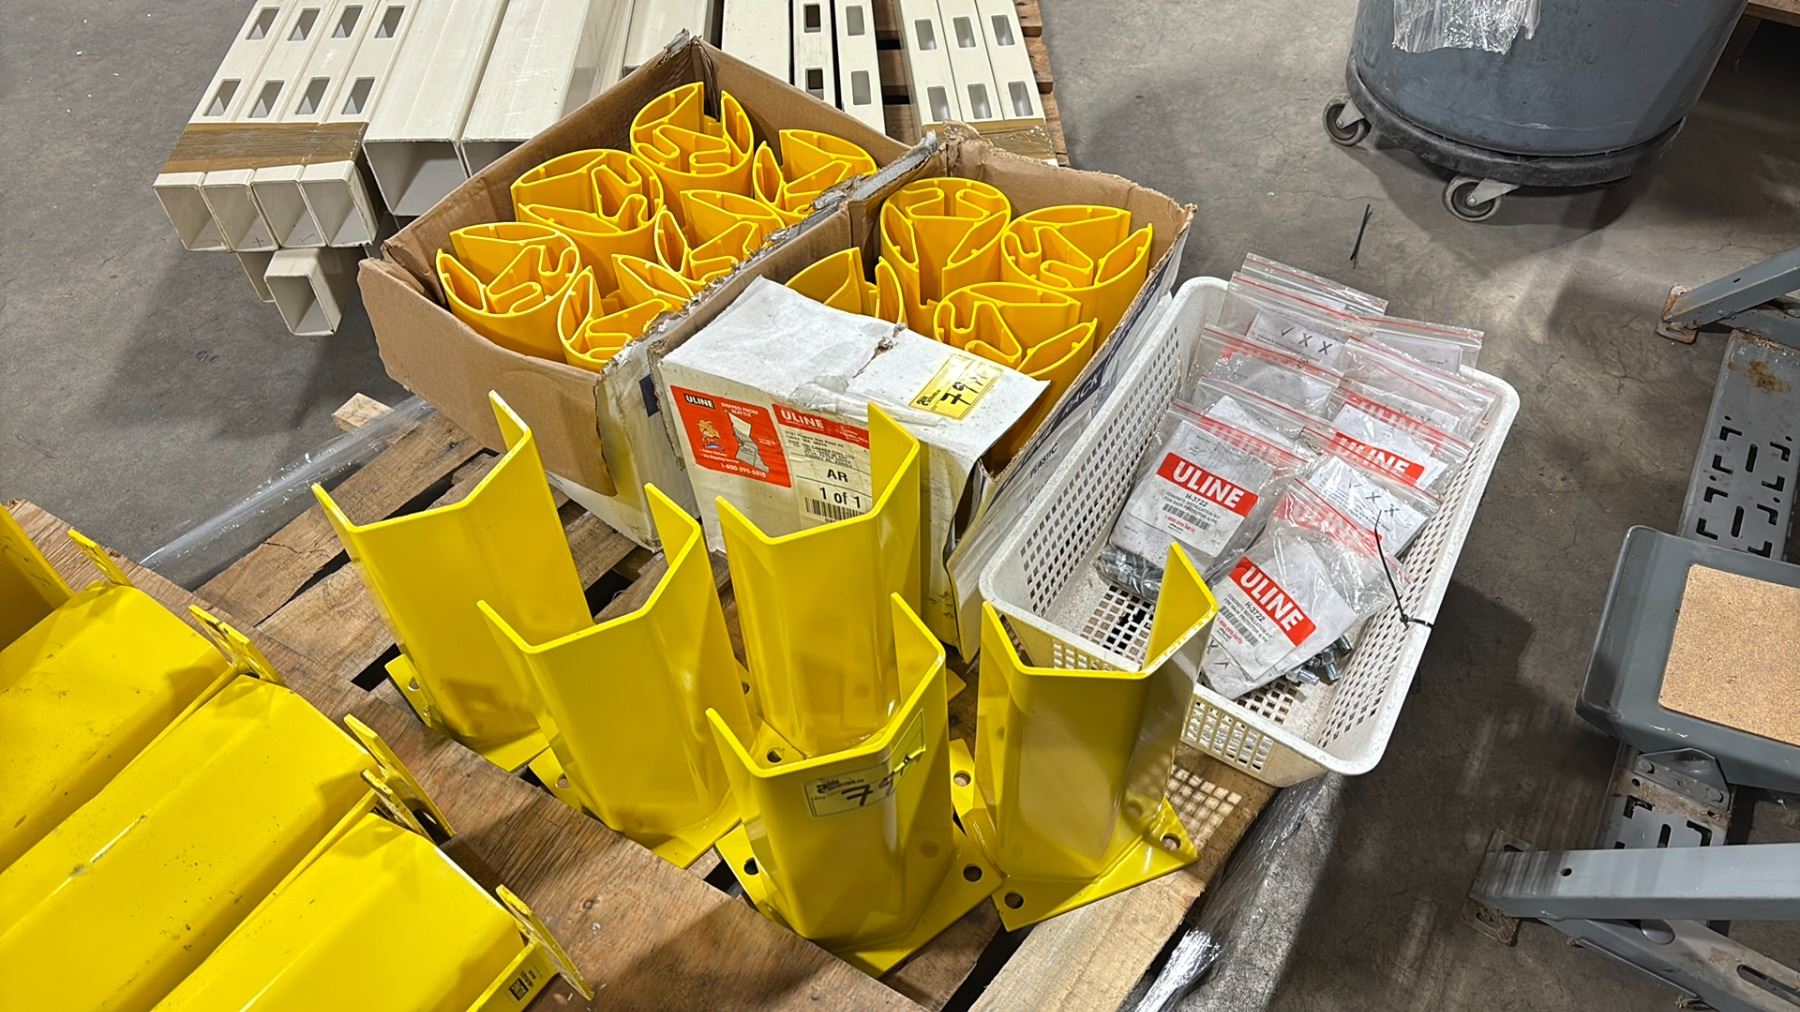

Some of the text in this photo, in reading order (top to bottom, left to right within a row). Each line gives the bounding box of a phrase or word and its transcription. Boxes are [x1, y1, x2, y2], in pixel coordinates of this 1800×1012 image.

[685, 394, 715, 409] ULINE
[780, 410, 824, 429] ULINE
[827, 469, 849, 483] AR
[1172, 461, 1245, 509] ULINE
[820, 487, 861, 509] 1 of 1
[1185, 493, 1209, 507] H-3722
[1240, 566, 1304, 632] ULINE
[1245, 601, 1265, 621] H-3722
